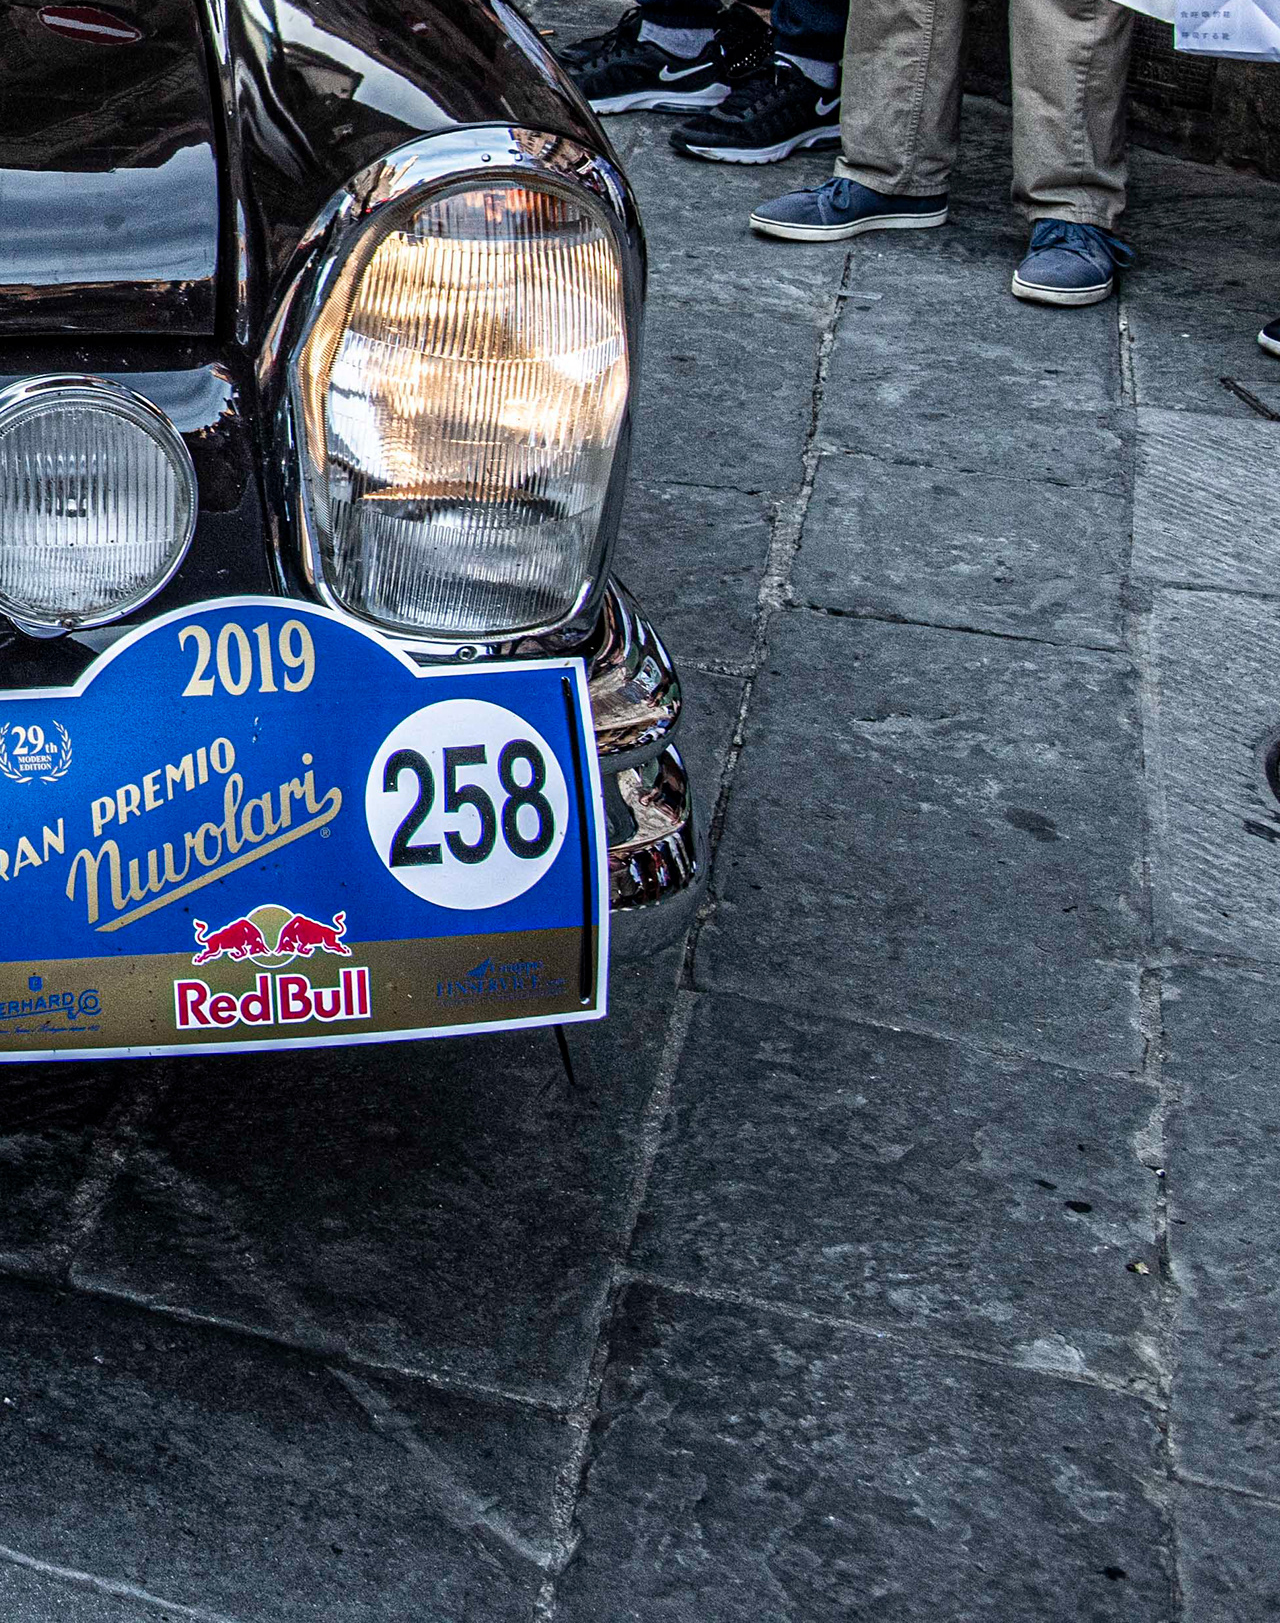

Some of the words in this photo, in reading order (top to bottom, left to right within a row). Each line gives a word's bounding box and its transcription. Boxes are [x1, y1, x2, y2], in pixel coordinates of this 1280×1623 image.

[178, 619, 316, 697] 2019
[11, 724, 58, 756] 29th
[17, 755, 52, 764] MODERN
[19, 763, 52, 772] EDITION
[90, 737, 236, 838] PREMIO
[382, 738, 556, 869] 258
[65, 752, 342, 928] Nuvolari
[176, 974, 272, 1027] Red
[277, 969, 369, 1021] Bull
